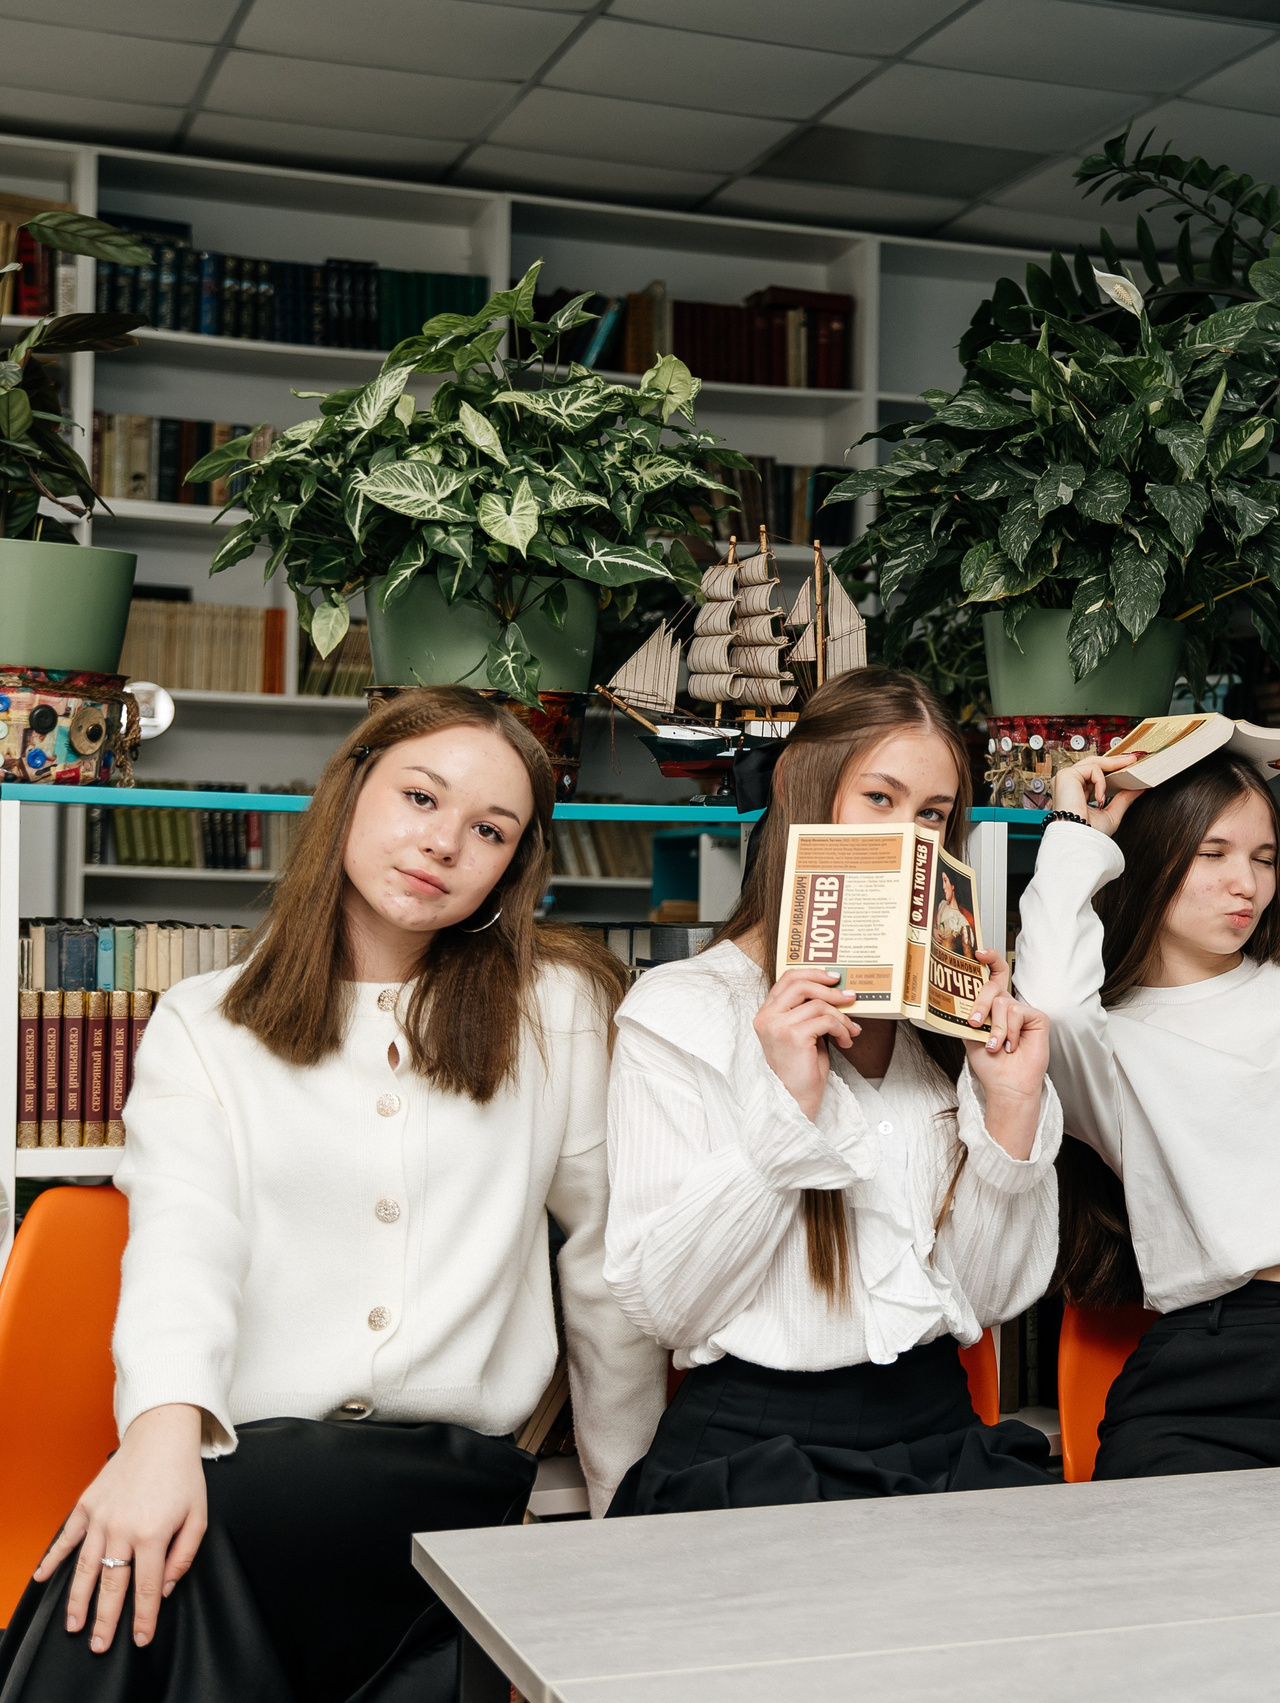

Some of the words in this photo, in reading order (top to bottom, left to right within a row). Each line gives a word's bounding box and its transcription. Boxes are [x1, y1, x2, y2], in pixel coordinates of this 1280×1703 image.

[914, 844, 928, 891] ТЮТЧЕВ
[792, 876, 807, 926] ИВАНОВИЧ
[912, 908, 923, 922] Ф.
[913, 894, 924, 906] И.
[808, 876, 840, 961] ТЮТЧЕВ
[789, 928, 803, 960] ФЕДОР
[949, 959, 981, 974] ИВАНОВИЧ
[94, 1028, 102, 1047] ВЕК
[115, 1028, 124, 1046] ВЕК
[25, 1028, 36, 1090] СЕРЕБРЯНЫЙ
[46, 1027, 57, 1089] СЕРЕБРЯНЫЙ
[69, 1027, 79, 1089] СЕРЕБРЯНЫЙ
[91, 1050, 102, 1112] СЕРЕБРЯНЫЙ
[113, 1049, 124, 1111] СЕРЕБРЯНЫЙ
[25, 1093, 34, 1112] ВЕК
[46, 1093, 55, 1112] ВЕК
[68, 1092, 77, 1111] ВЕК
